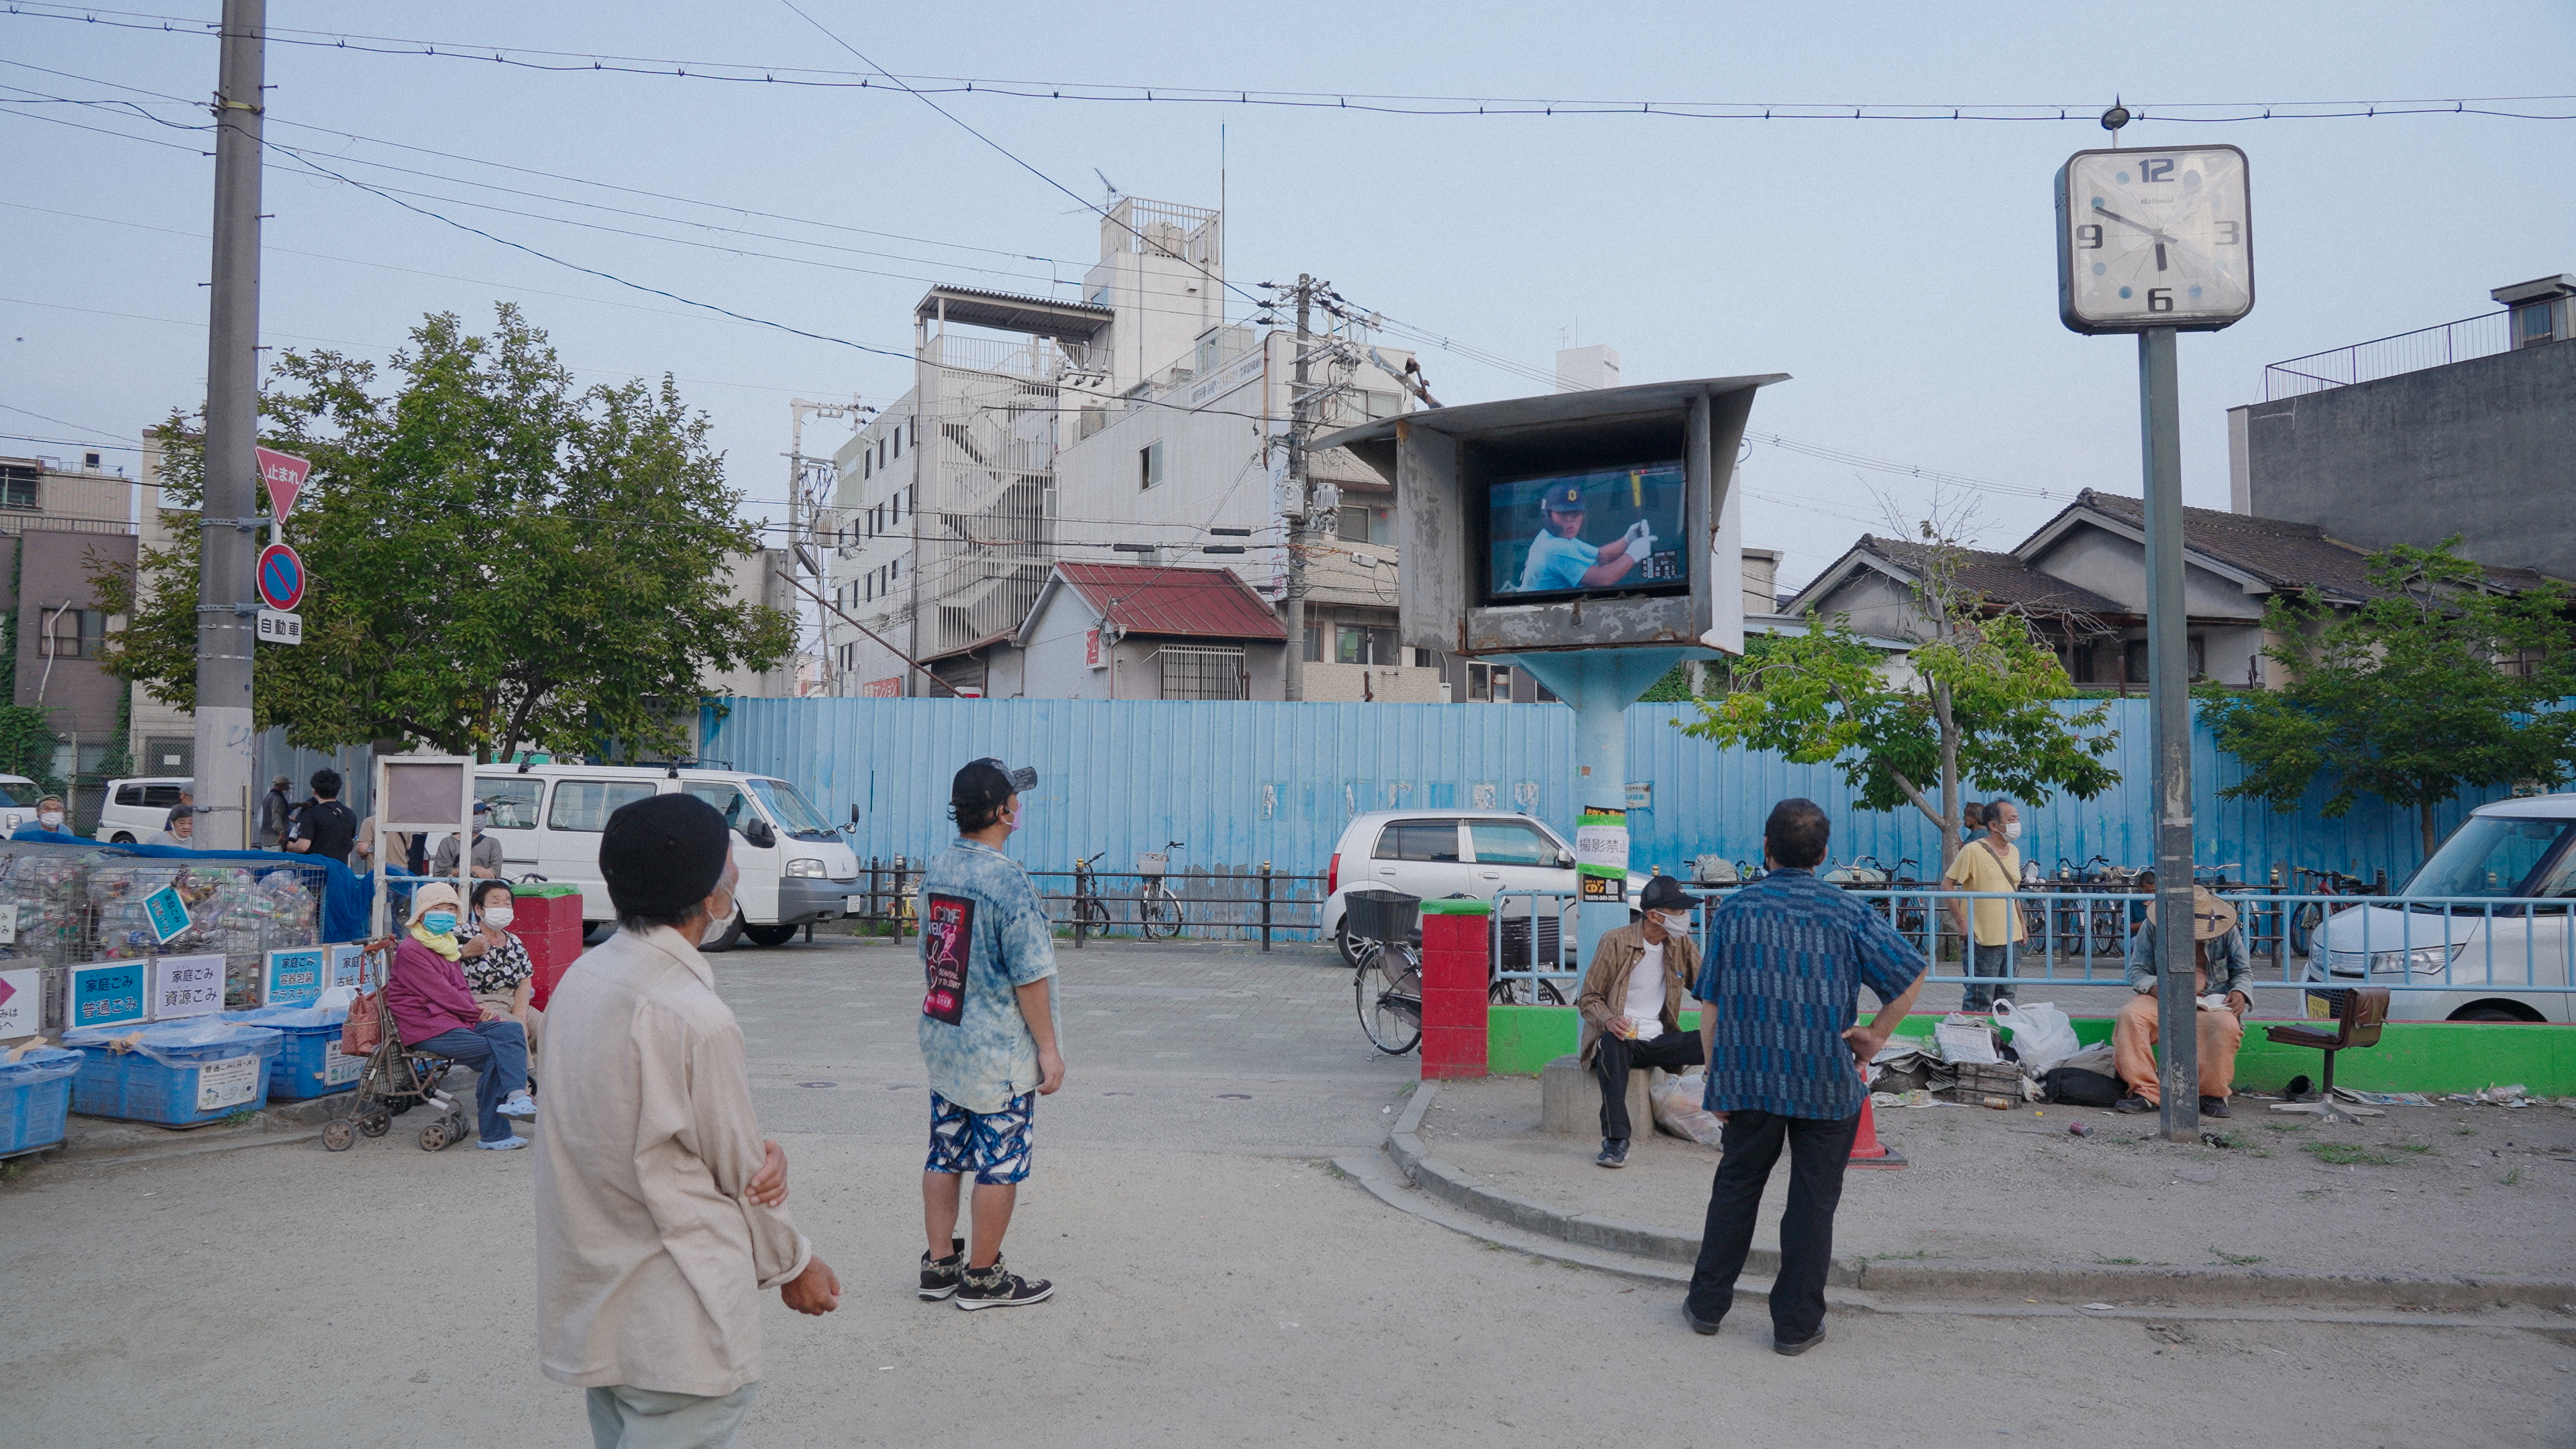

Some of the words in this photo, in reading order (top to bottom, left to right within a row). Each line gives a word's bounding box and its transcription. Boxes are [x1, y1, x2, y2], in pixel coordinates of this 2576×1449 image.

[2139, 158, 2175, 182] 12
[2077, 224, 2103, 249] 9
[2214, 220, 2240, 246] 3
[2147, 288, 2174, 312] 6
[266, 464, 299, 485] 止まれ
[261, 617, 300, 637] 自動車
[1086, 629, 1099, 667] 酒
[1579, 837, 1626, 853] 撮影禁止
[1585, 883, 1605, 893] CD's
[282, 957, 315, 968] 家庭ごみ
[86, 975, 133, 993] 家庭ごみ
[172, 968, 214, 983] 家庭ごみ
[280, 973, 313, 985] 容器包装
[337, 973, 376, 986] 古紙・衣
[165, 987, 217, 1007] 資源ごみ
[271, 987, 320, 1001] プラスチック
[83, 996, 138, 1018] 普通ごみ
